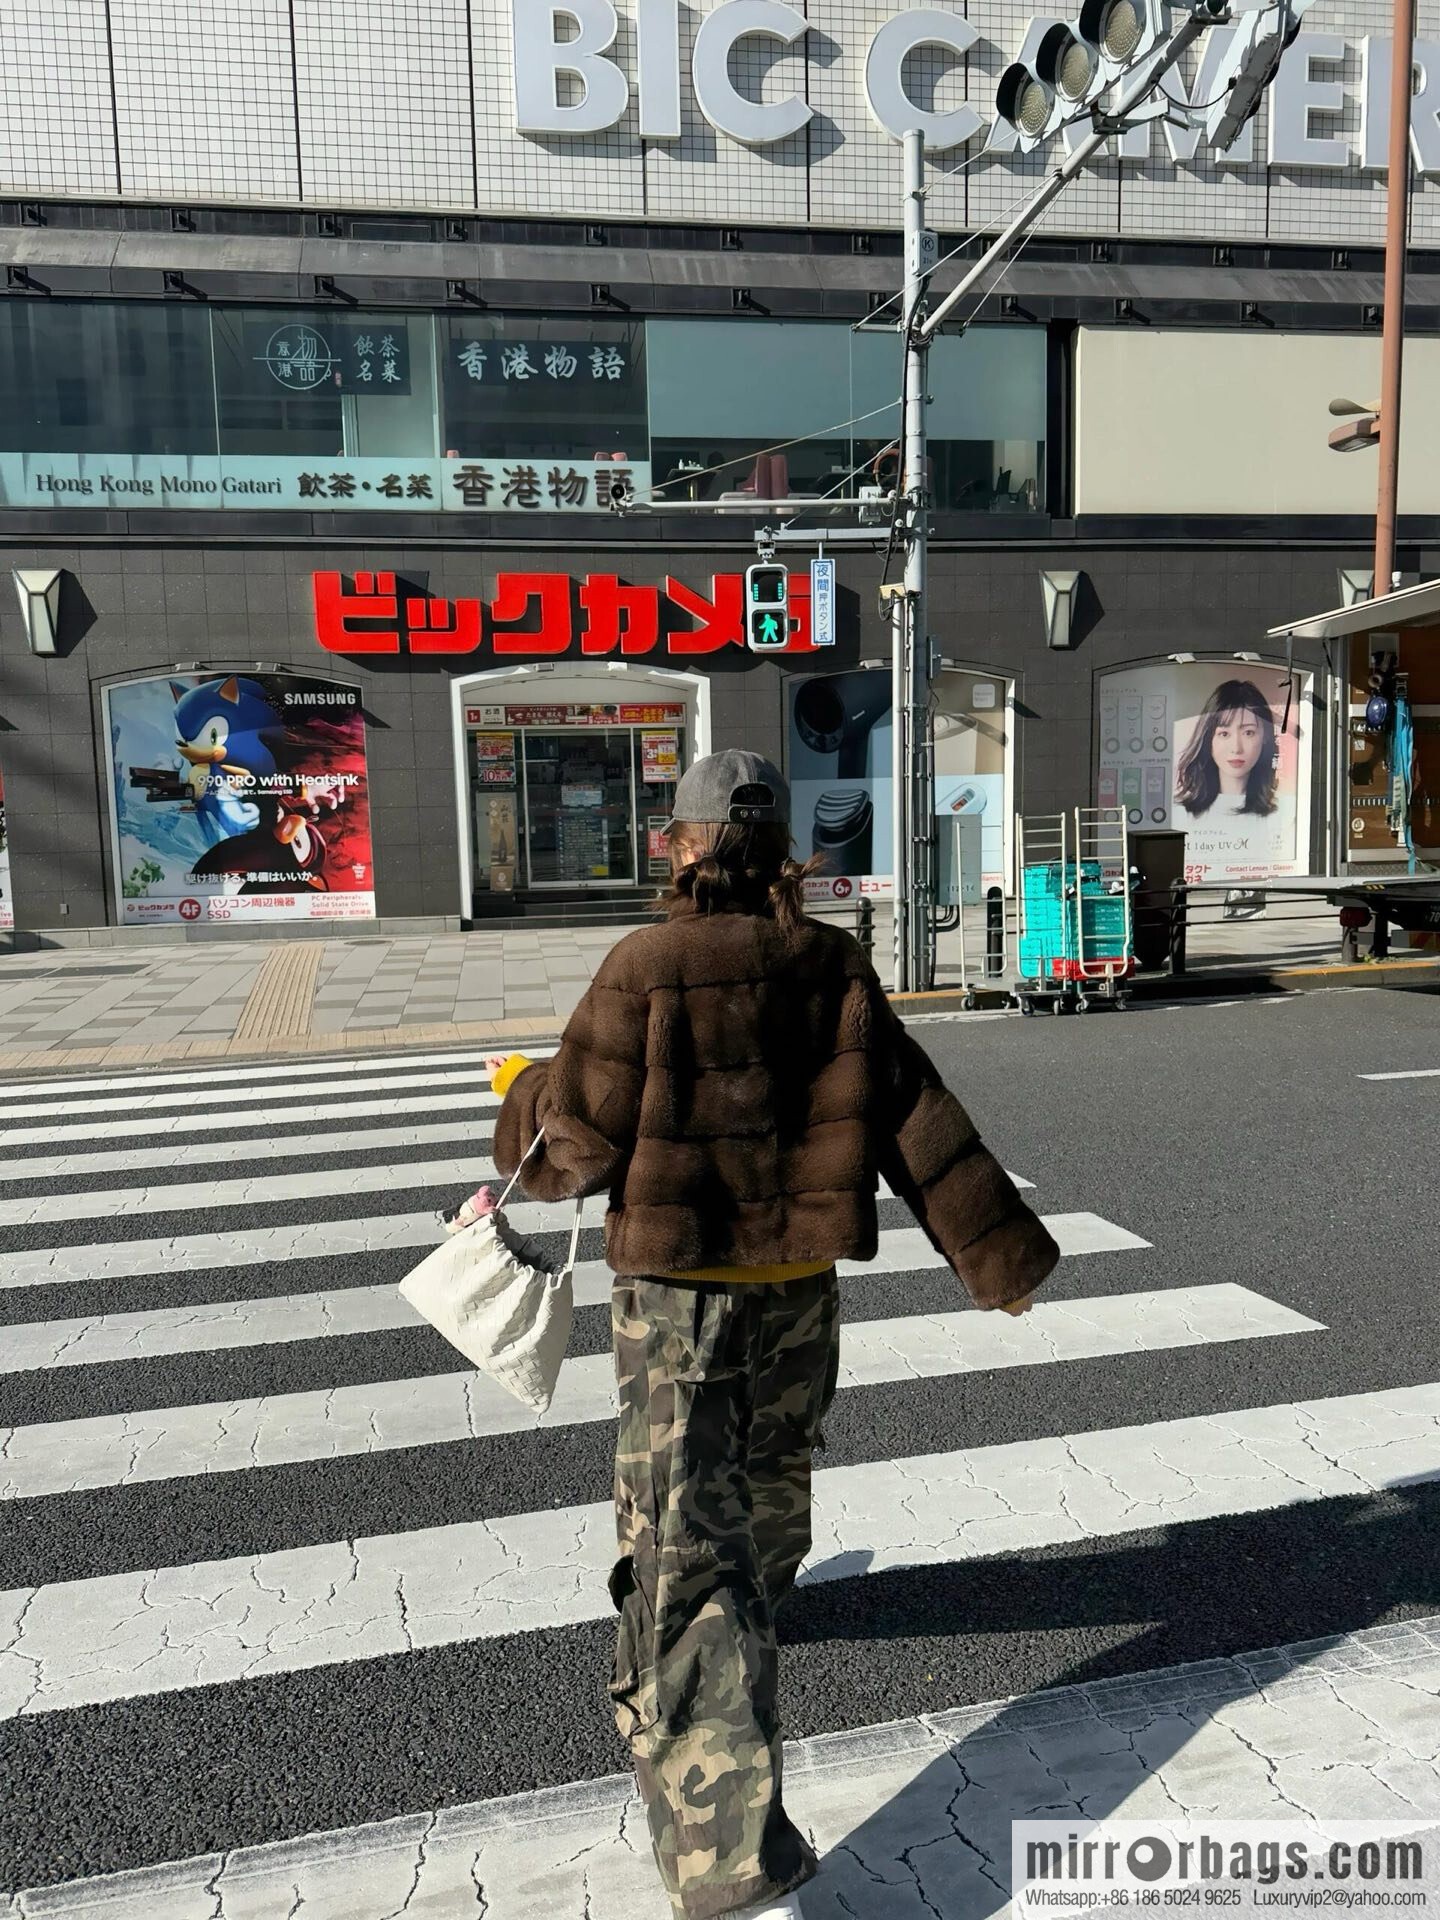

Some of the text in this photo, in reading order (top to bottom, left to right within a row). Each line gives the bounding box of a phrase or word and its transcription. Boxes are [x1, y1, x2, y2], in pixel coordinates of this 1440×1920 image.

[513, 0, 812, 146] BIC
[457, 341, 626, 381] 香港物語
[36, 473, 282, 496] Hong Kong Mono Gatari
[284, 693, 356, 705] SAMSUNG
[198, 773, 359, 787] 990 PRO with Heatsink
[835, 881, 850, 896] 6F
[181, 902, 199, 916] 4F
[207, 896, 295, 908] パソコン周辺機器
[207, 910, 231, 919] SSD
